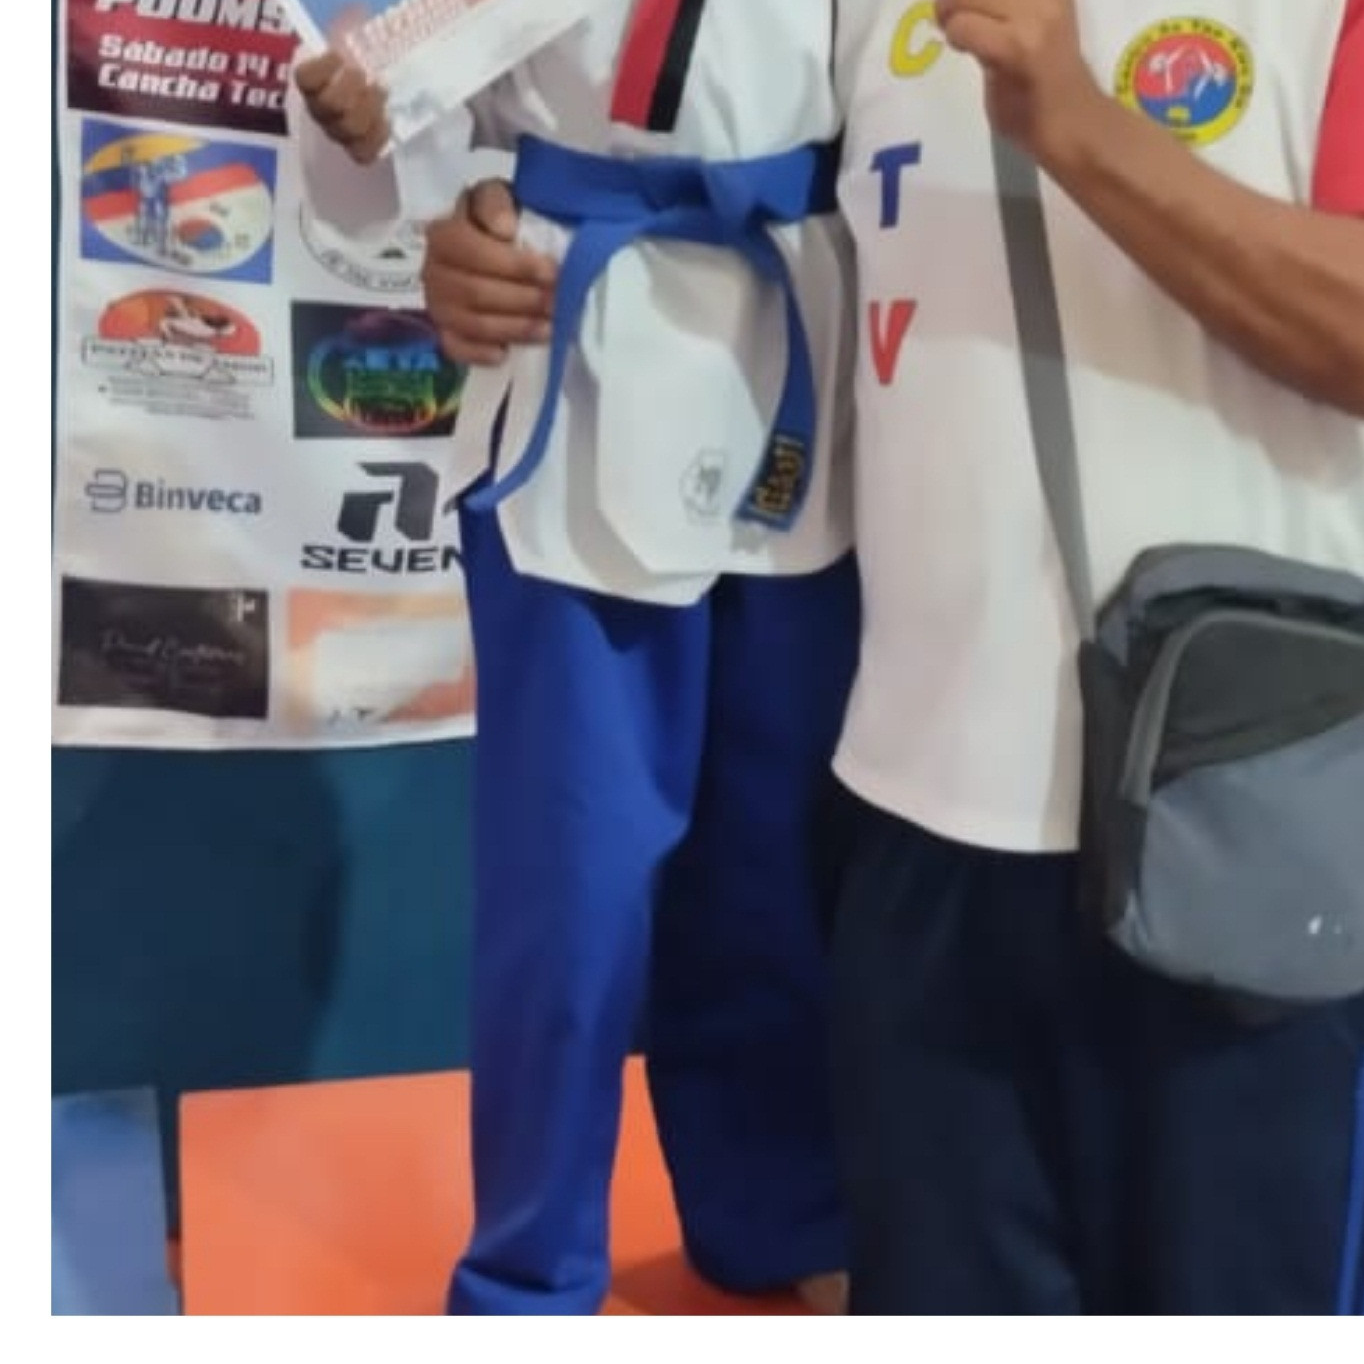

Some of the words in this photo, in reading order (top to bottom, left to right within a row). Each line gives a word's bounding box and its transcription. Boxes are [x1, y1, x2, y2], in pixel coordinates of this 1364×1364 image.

[97, 62, 222, 103] Cancha
[869, 142, 922, 229] T
[869, 299, 918, 387] V
[134, 479, 263, 516] Binveca
